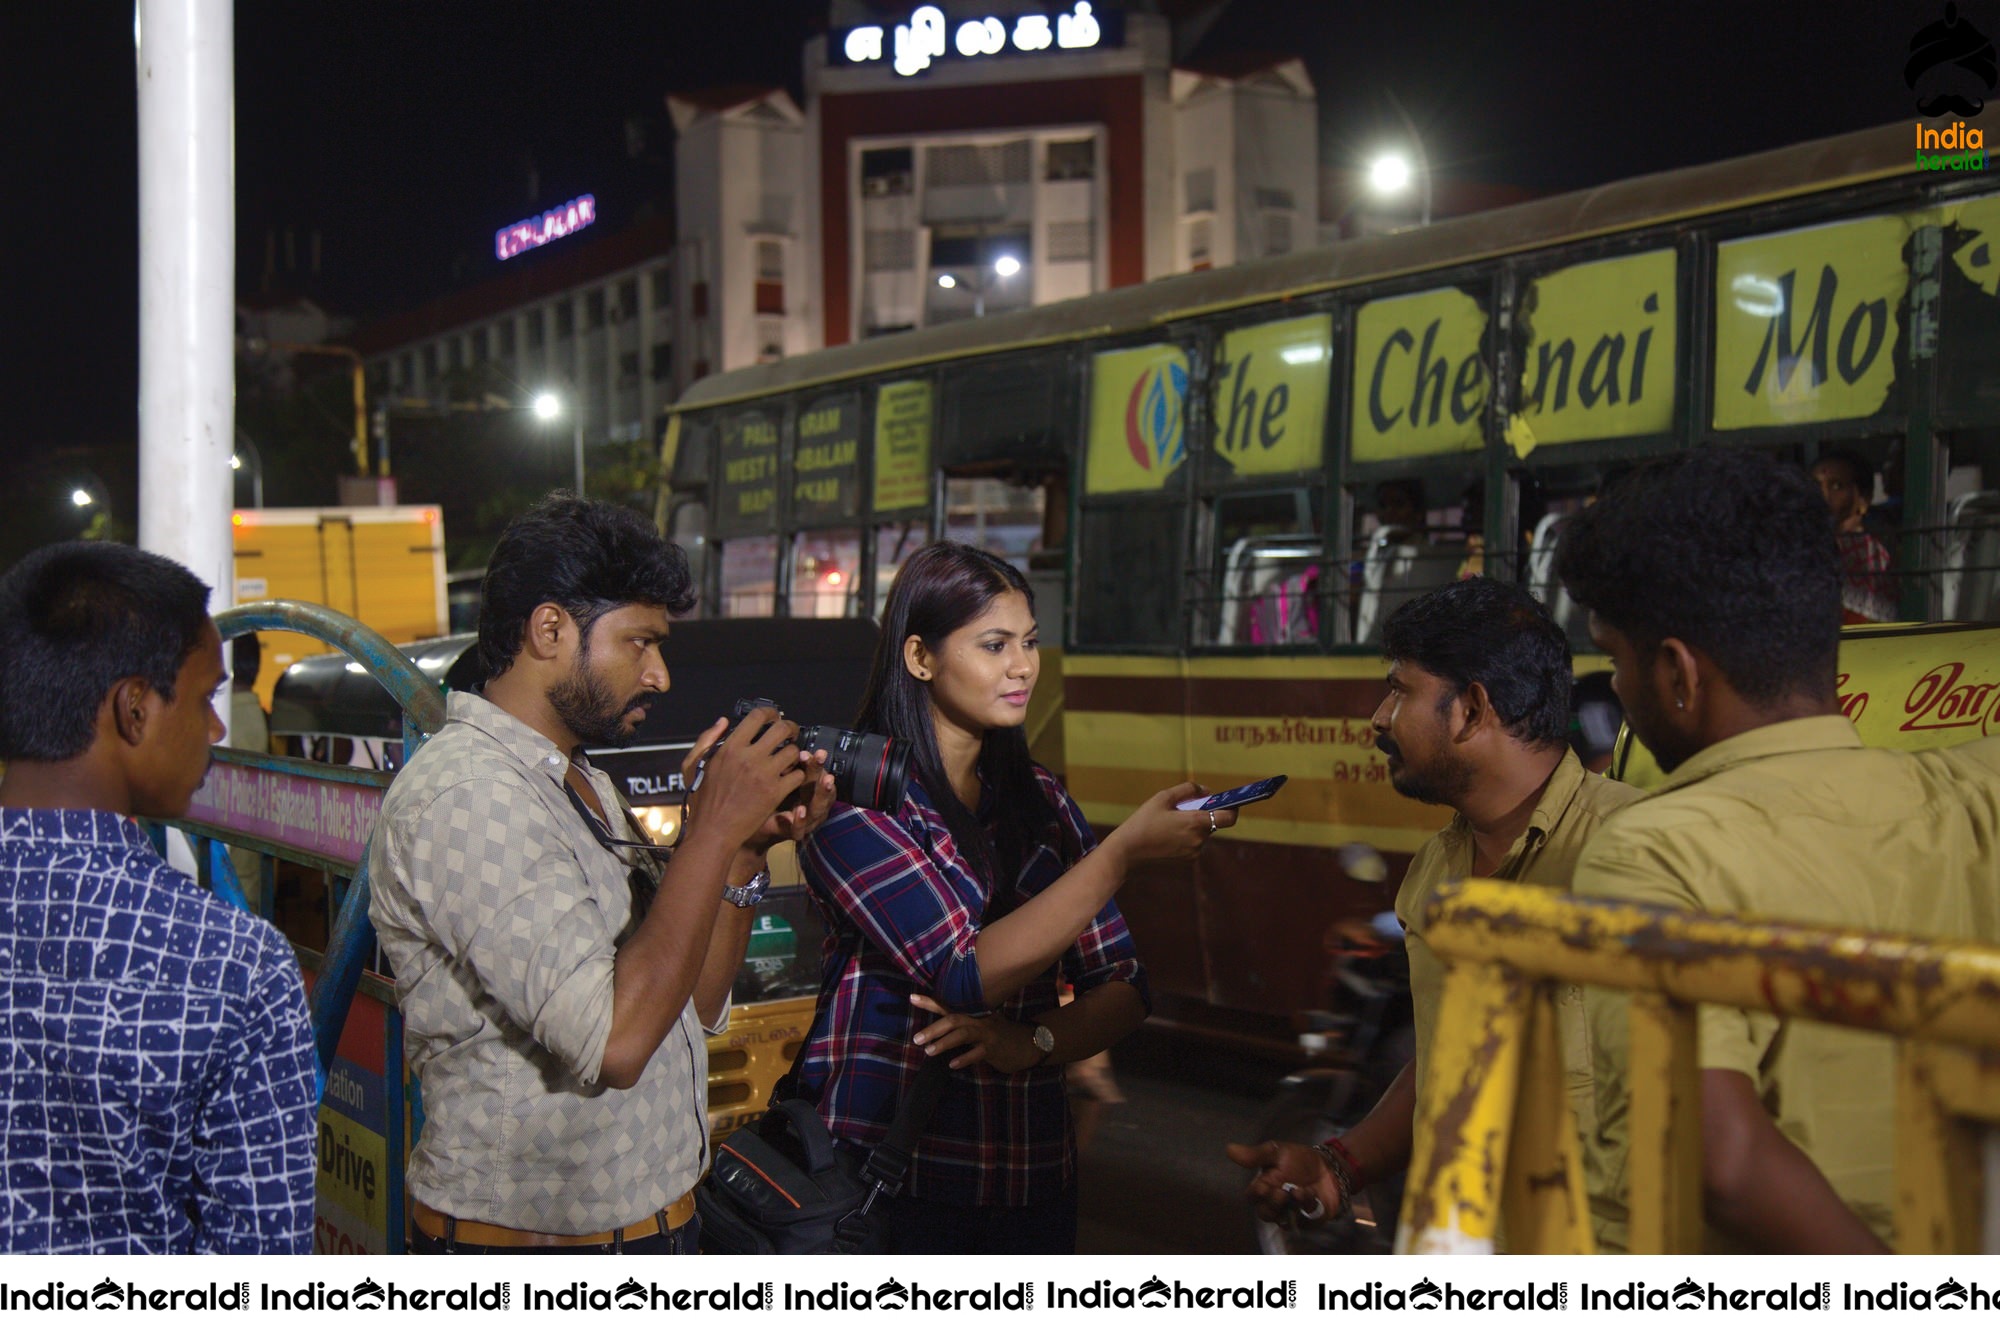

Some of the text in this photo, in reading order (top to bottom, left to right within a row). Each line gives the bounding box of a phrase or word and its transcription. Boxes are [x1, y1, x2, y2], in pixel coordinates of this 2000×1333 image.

[1369, 293, 1660, 433] Chenai
[1744, 263, 1888, 397] Mo
[627, 776, 668, 795] TOLL
[321, 786, 351, 841] Police
[354, 792, 380, 844] Stati
[325, 1068, 364, 1111] tation
[321, 1120, 376, 1200] Drive
[316, 1215, 367, 1255] ST
